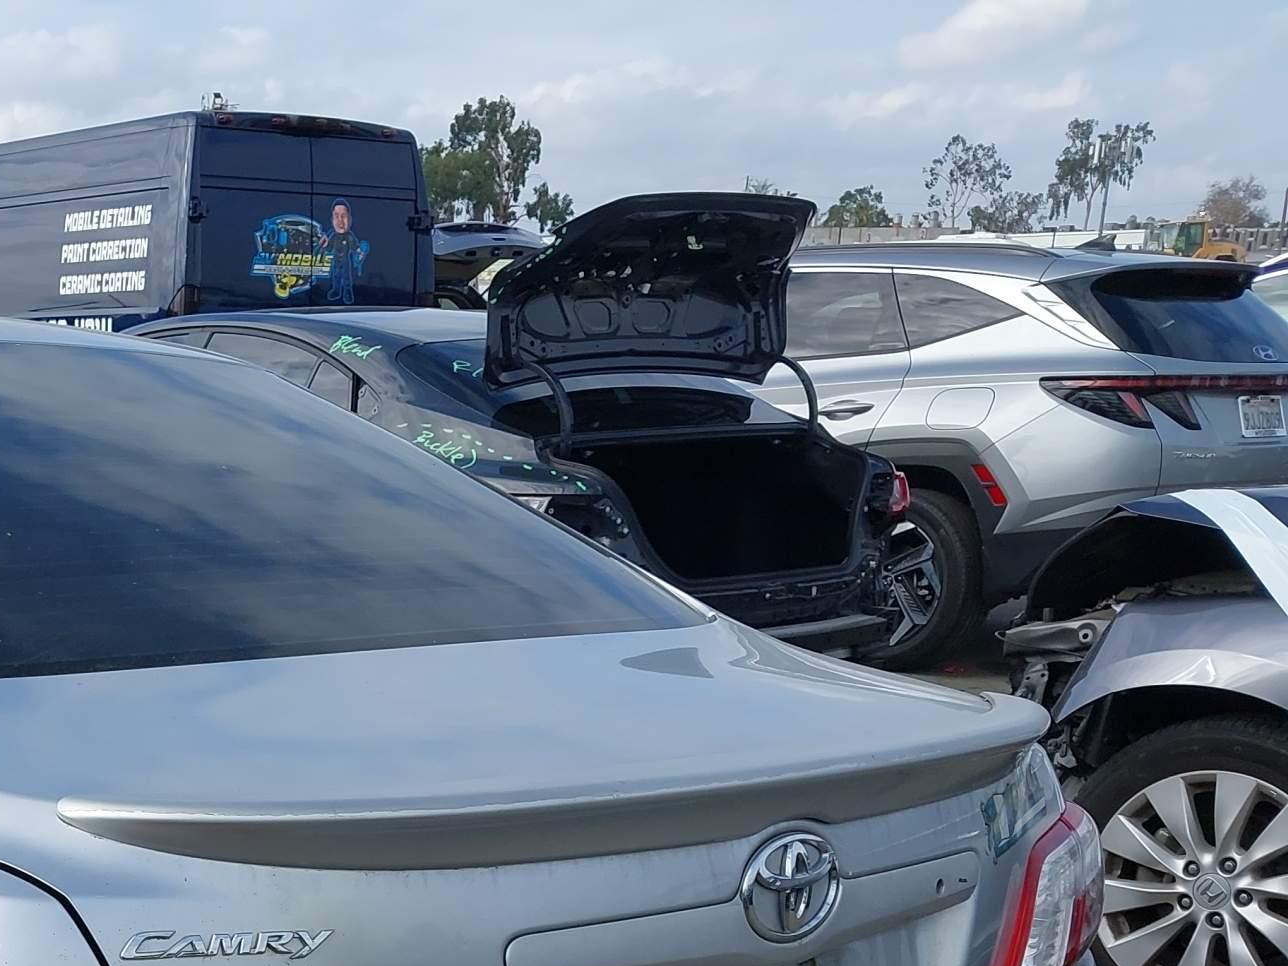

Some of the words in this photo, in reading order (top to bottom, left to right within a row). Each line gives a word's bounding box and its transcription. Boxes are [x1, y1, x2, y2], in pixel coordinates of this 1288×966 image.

[64, 210, 100, 232] MOBILE
[99, 205, 152, 229] DETAILING
[61, 243, 89, 264] PAINT
[89, 238, 149, 262] CORRECTION
[277, 253, 334, 267] MOBILE
[59, 273, 101, 295] CERAMIC
[102, 270, 146, 292] COATING
[329, 335, 382, 360] Blend
[119, 929, 335, 960] CAMRY
